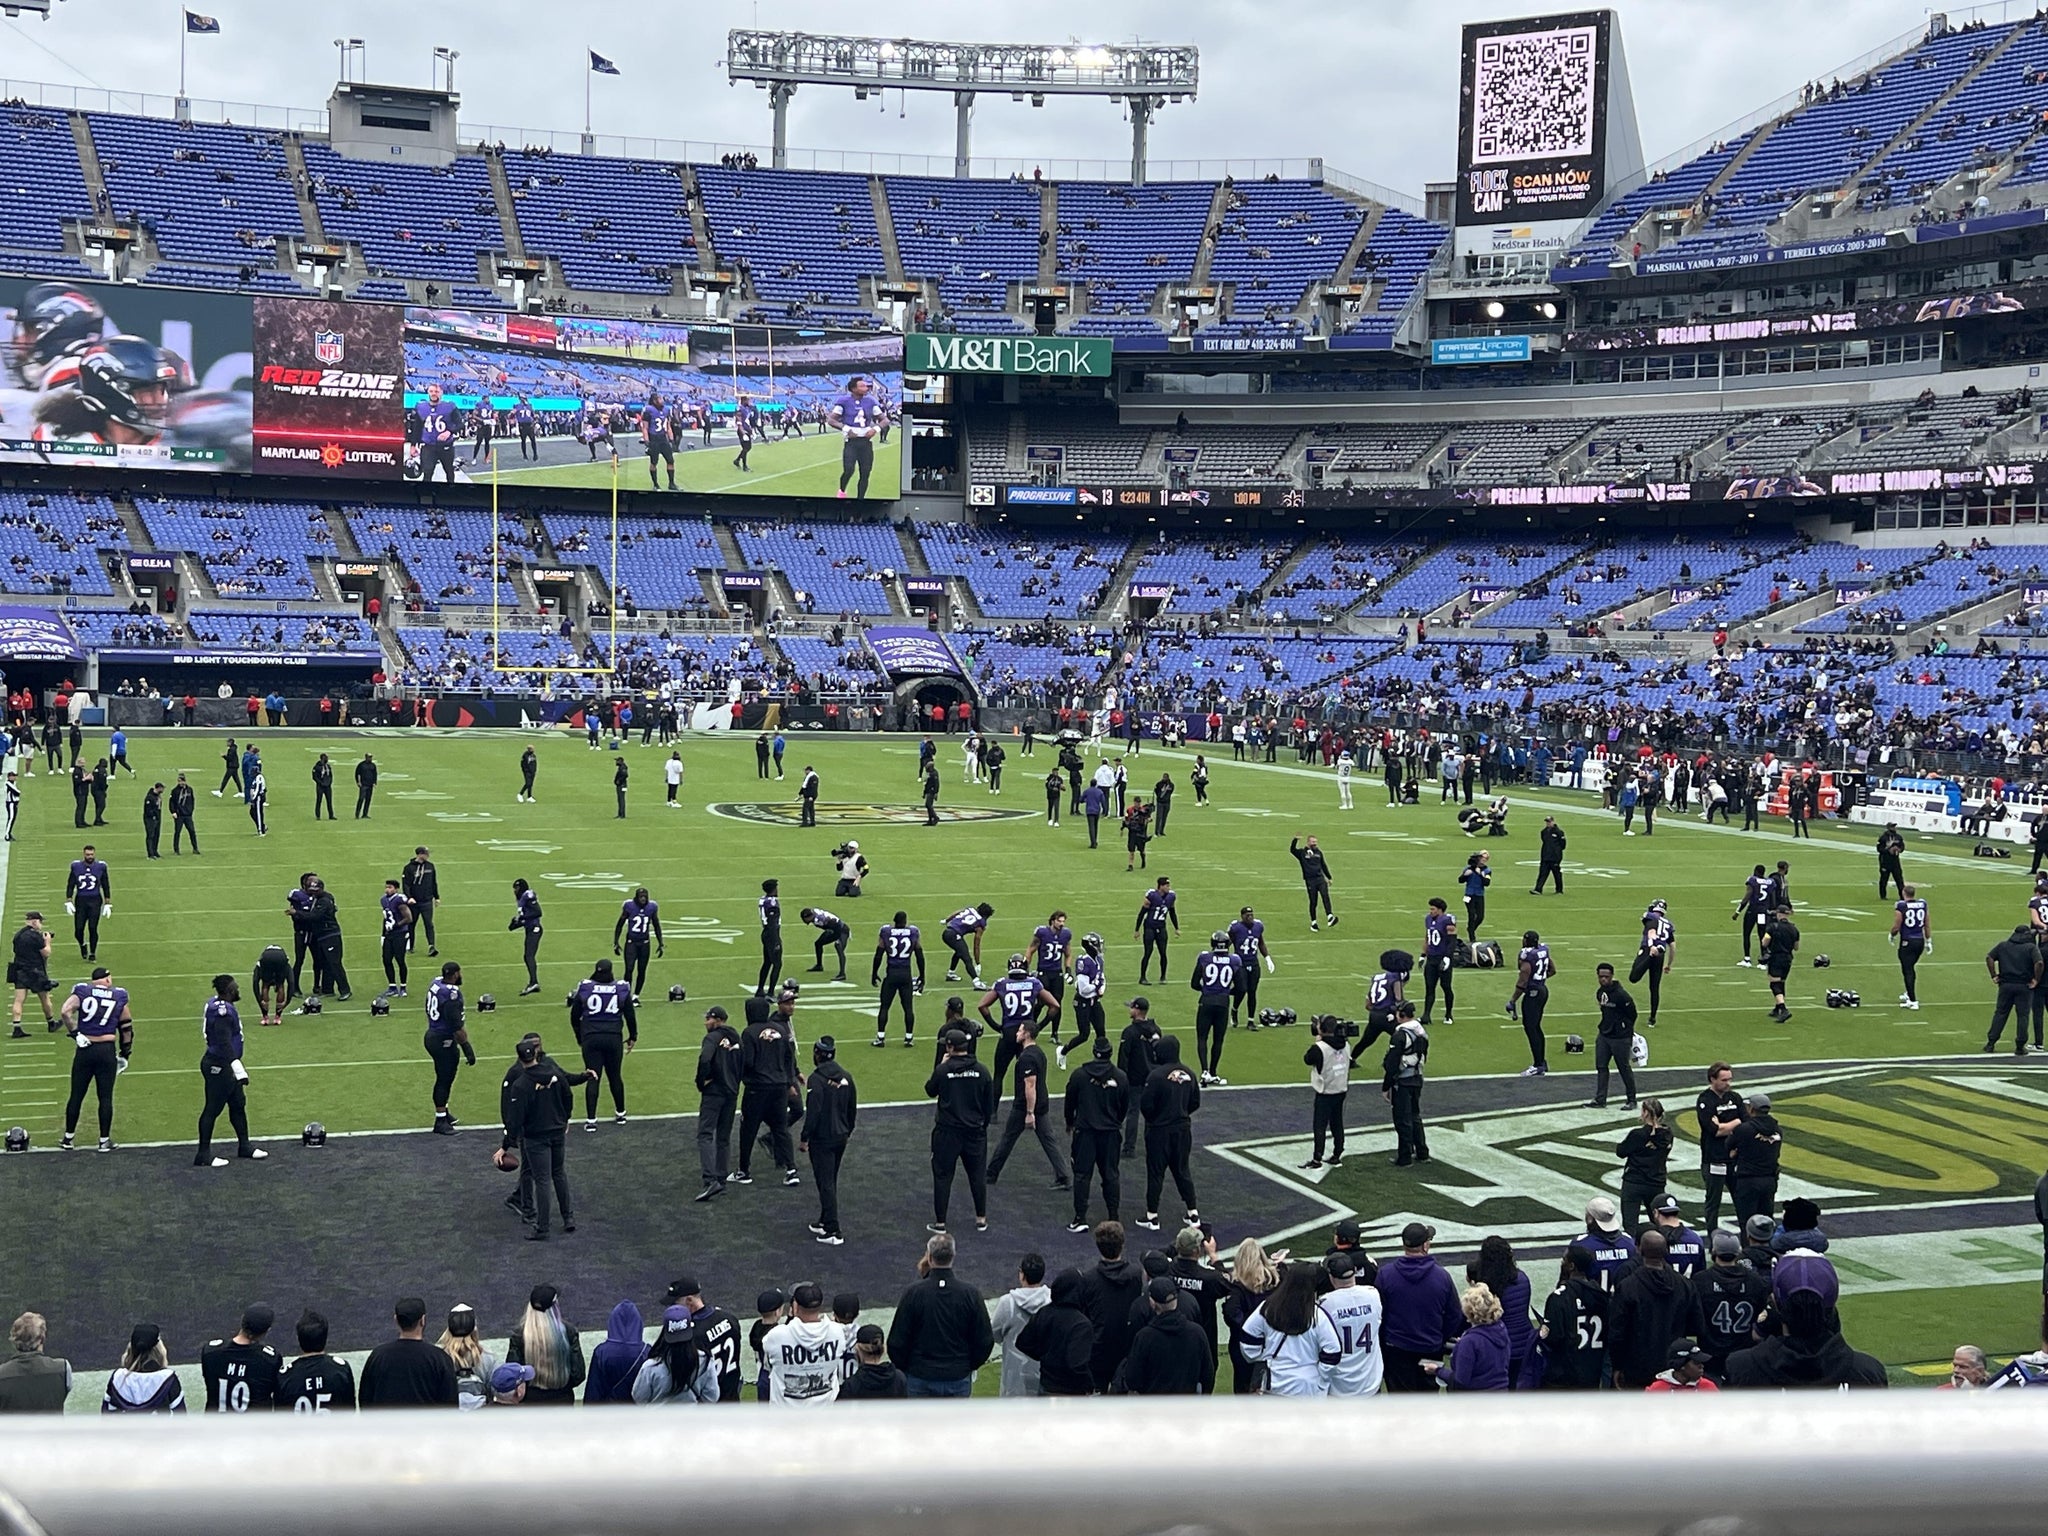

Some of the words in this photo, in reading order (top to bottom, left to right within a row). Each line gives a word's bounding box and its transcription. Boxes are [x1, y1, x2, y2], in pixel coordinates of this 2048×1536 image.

[1470, 169, 1508, 193] FLOCK
[1513, 174, 1553, 188] SCAN
[1555, 170, 1592, 185] NOW
[1474, 192, 1502, 212] CAM
[1492, 240, 1530, 251] MedStar
[1533, 237, 1565, 249] Health
[1783, 246, 1817, 259] TERRELL
[1818, 243, 1845, 255] SUGGS
[1846, 237, 1887, 252] 2003-2018
[1646, 262, 1686, 273] MARSHAL
[1687, 259, 1715, 270] YANDA
[1716, 253, 1759, 267] 2007-2019
[1657, 325, 1712, 345] PREGAME
[1714, 320, 1769, 340] WARMUPS
[320, 344, 340, 359] NFL
[1203, 340, 1218, 350] TEXT
[1220, 340, 1233, 350] FOR
[1234, 340, 1250, 350] HELP
[927, 336, 1011, 372] M&T
[1013, 339, 1092, 374] Bank
[291, 385, 319, 396] NFL
[321, 387, 393, 399] NETWORK
[424, 415, 446, 433] 46
[853, 408, 866, 428] 4
[41, 443, 52, 452] 13
[105, 446, 114, 455] 11
[261, 447, 320, 460] MARYLAND
[1832, 472, 1882, 493] PREGAME
[1883, 469, 1942, 491] WARMUPS
[974, 489, 992, 501] 25
[1009, 490, 1074, 501] PROGRESSIVE
[1102, 489, 1113, 505] 13
[1159, 489, 1168, 506] 11
[1249, 492, 1261, 504] PM
[1490, 487, 1544, 504] PREGAME
[1545, 485, 1606, 503] WARMUPS
[174, 655, 193, 663] BUD
[194, 656, 220, 664] LIGHT
[221, 656, 282, 665] TOUCHDOWN
[284, 657, 307, 665] CLUB
[1887, 799, 1924, 809] RAVENS
[78, 875, 96, 890] 53
[1758, 884, 1767, 901] 5
[1153, 906, 1168, 921] 12
[1904, 909, 1926, 928] 89
[2038, 905, 2048, 923] 8
[632, 915, 649, 933] 21
[889, 936, 912, 958] 32
[1044, 943, 1063, 961] 35
[1205, 963, 1233, 988] 90
[81, 996, 117, 1026] 97
[587, 994, 619, 1014] 94
[1004, 990, 1032, 1017] 95
[1595, 1248, 1628, 1261] HAMILTON
[1337, 1304, 1372, 1319] HAMILTON
[1711, 1300, 1754, 1334] 42
[1342, 1322, 1372, 1354] 14
[1577, 1315, 1603, 1350] 52
[782, 1341, 839, 1366] ROCKY
[238, 1364, 246, 1377] H
[305, 1378, 313, 1391] E
[315, 1376, 323, 1389] H
[218, 1377, 250, 1413] 10
